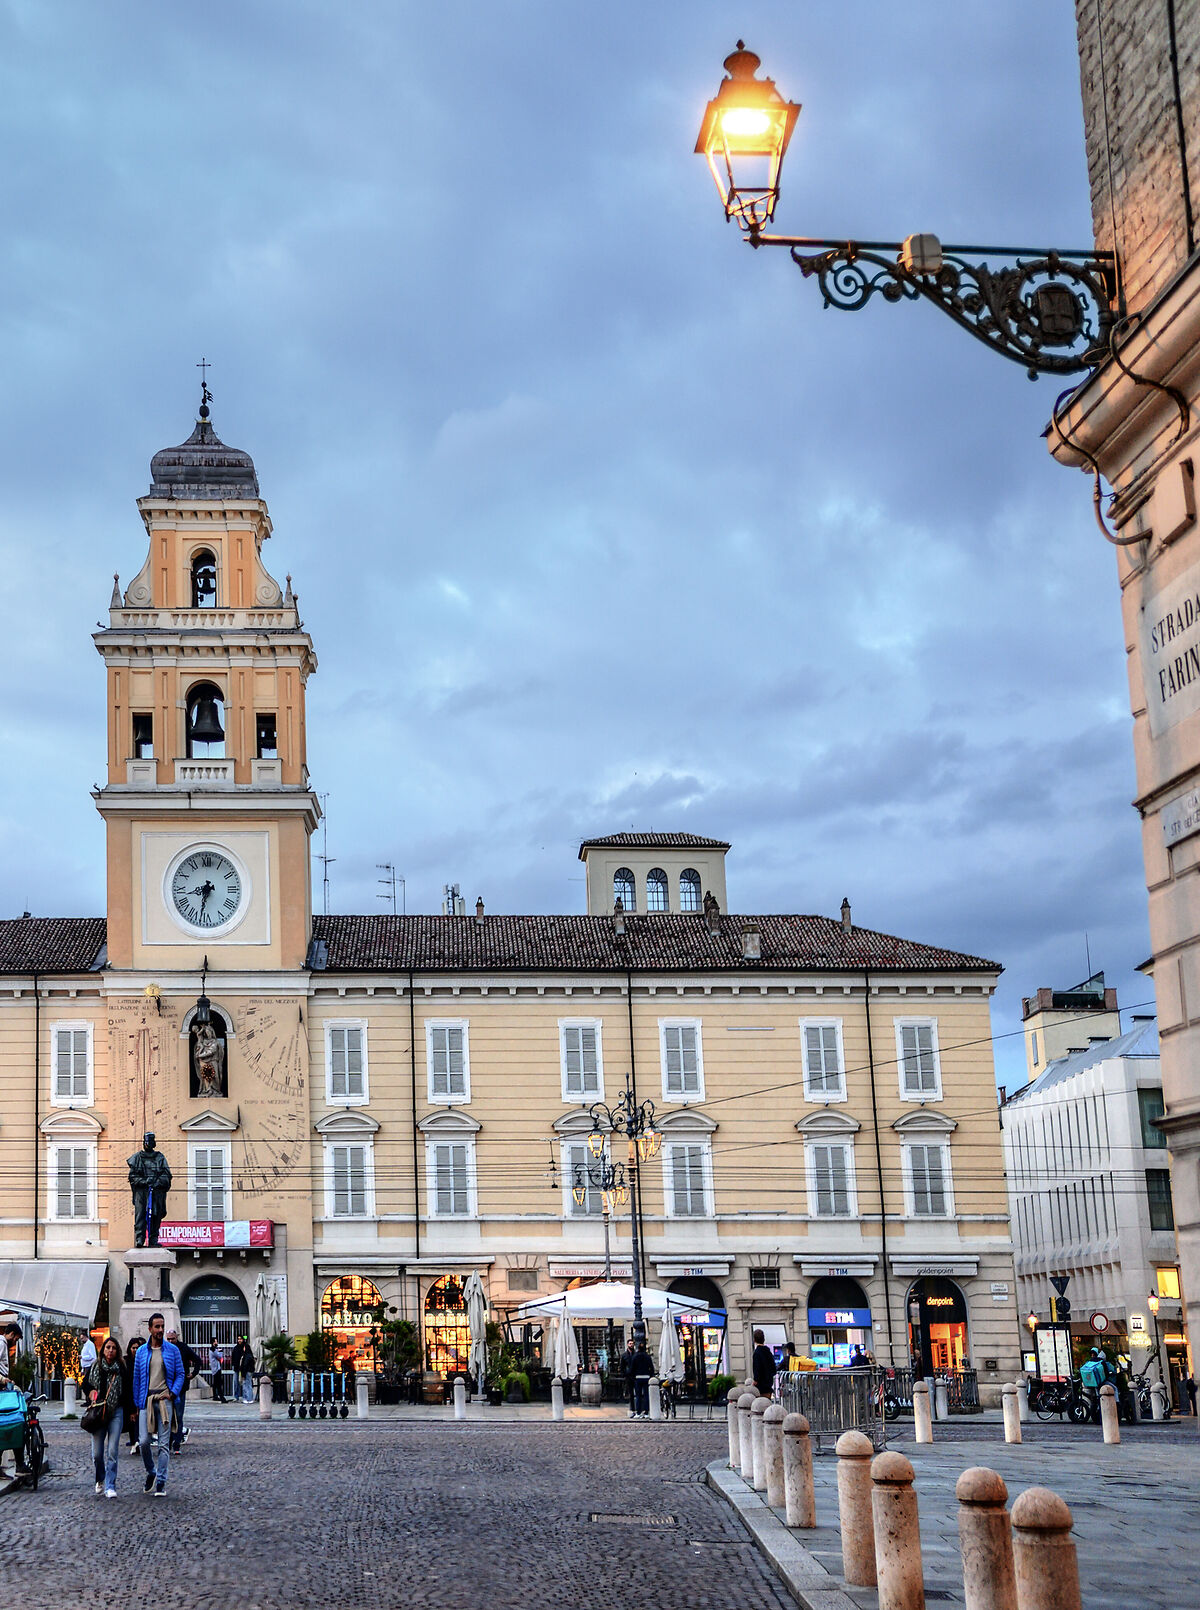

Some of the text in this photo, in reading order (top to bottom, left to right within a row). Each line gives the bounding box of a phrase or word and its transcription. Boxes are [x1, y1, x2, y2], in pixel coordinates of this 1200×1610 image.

[1151, 593, 1200, 654] STRADA
[201, 857, 211, 867] XII
[917, 1267, 954, 1275] goldenpoint
[835, 1312, 856, 1324] TIM
